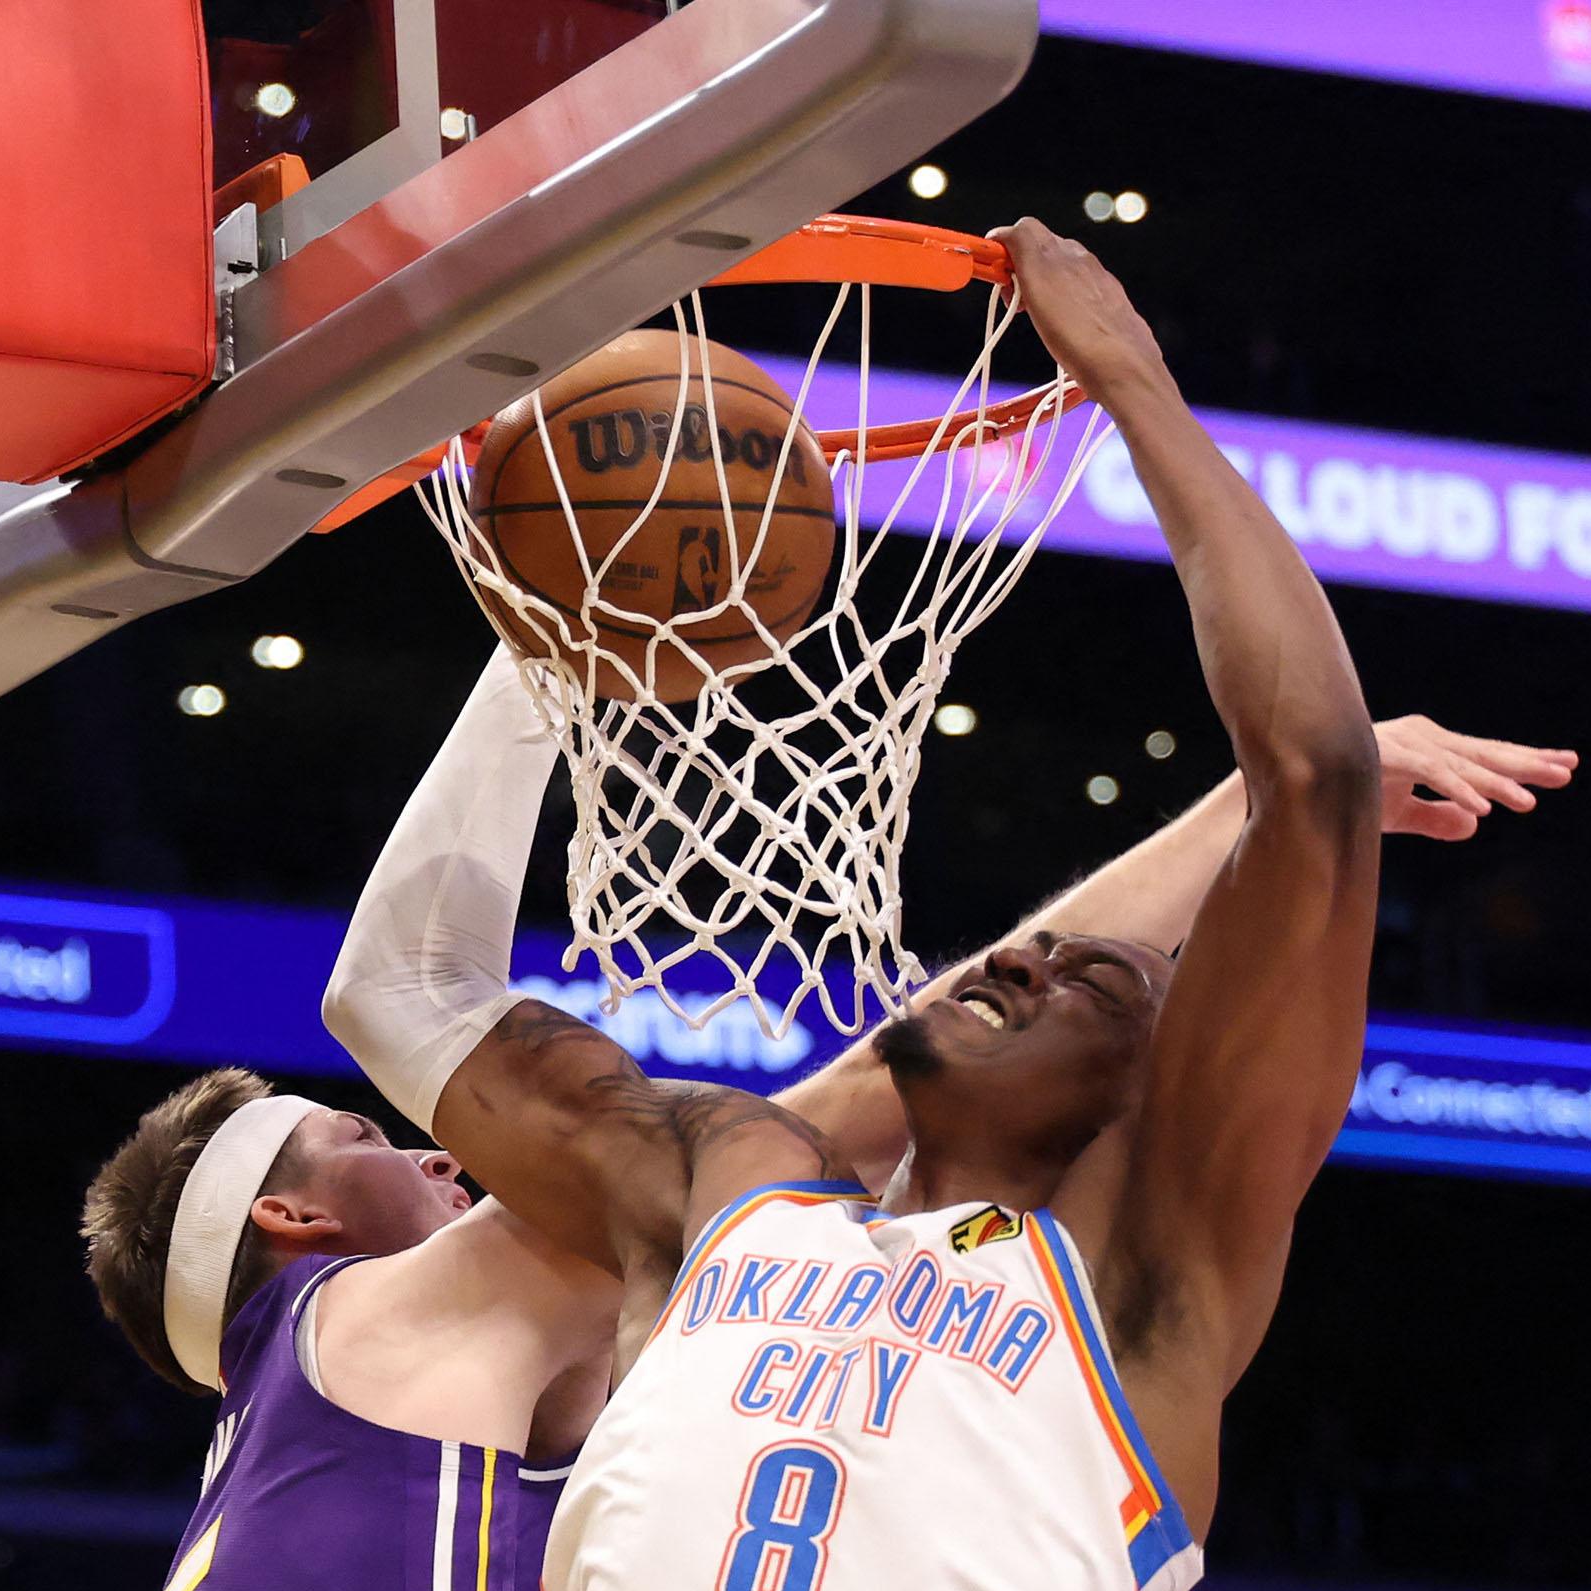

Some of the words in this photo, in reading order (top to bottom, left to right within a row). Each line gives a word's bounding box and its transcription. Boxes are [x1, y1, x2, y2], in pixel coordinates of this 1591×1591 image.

[569, 403, 807, 487] Wilson
[1263, 450, 1498, 563] LOUD
[681, 1249, 1055, 1395] OKLAOMA
[731, 1336, 921, 1438] CITY
